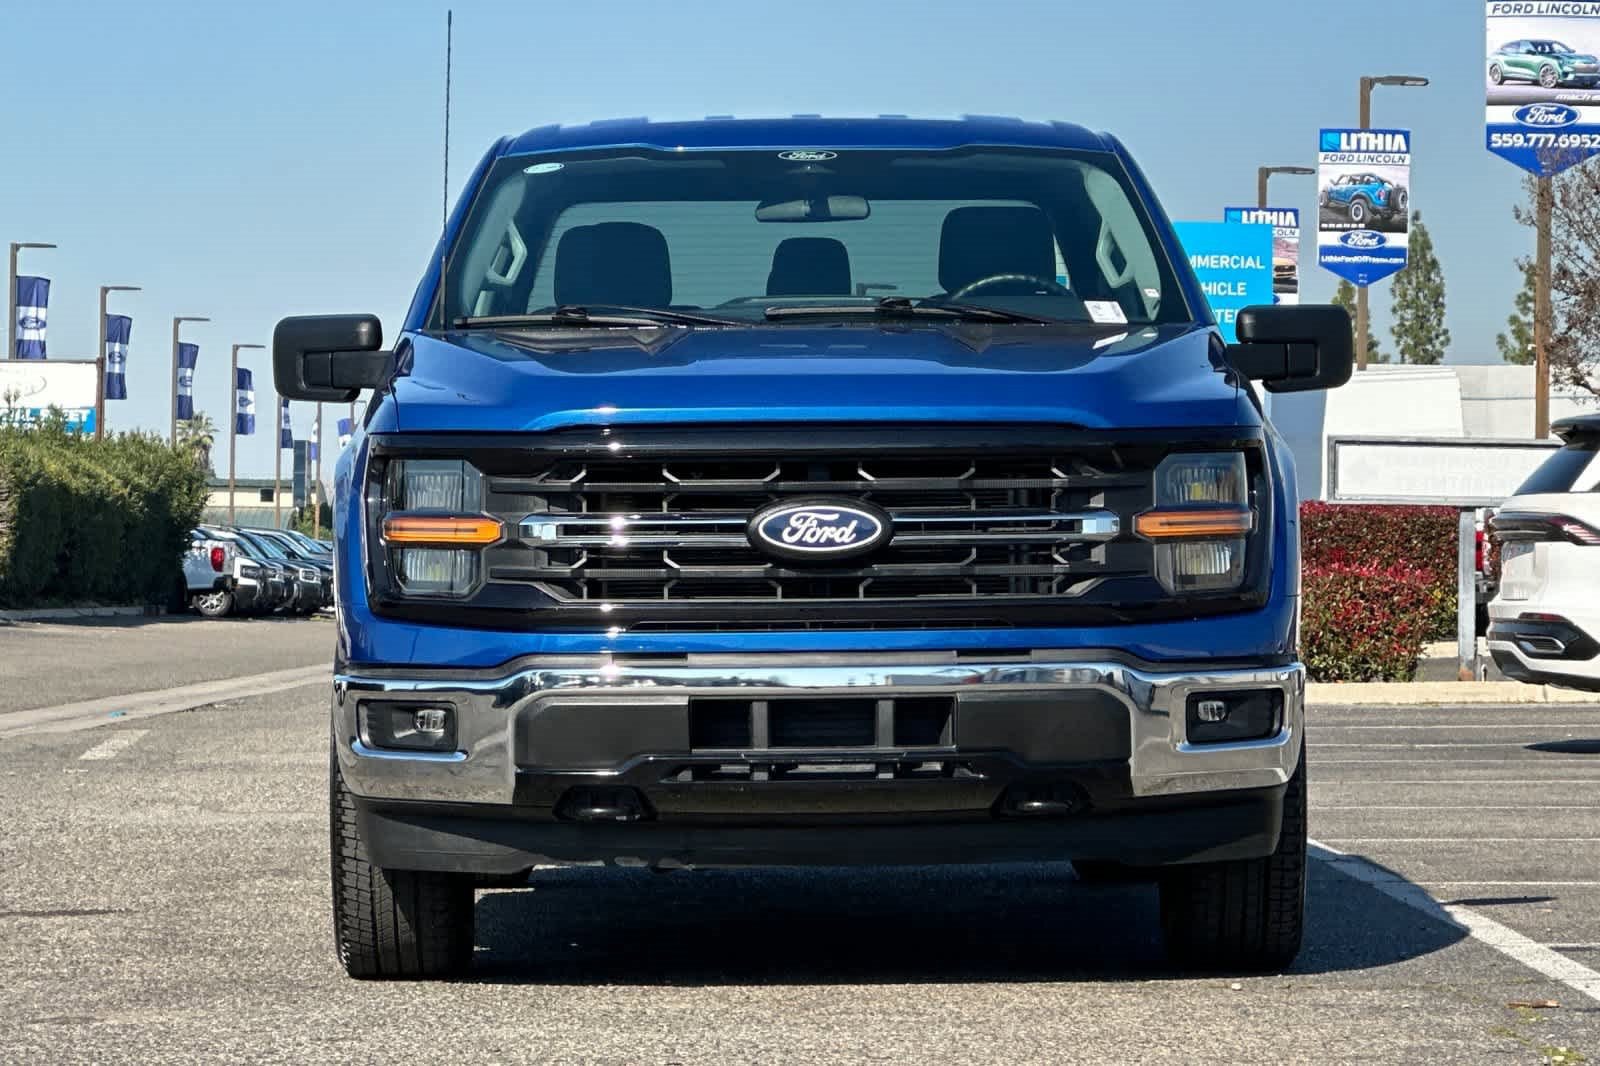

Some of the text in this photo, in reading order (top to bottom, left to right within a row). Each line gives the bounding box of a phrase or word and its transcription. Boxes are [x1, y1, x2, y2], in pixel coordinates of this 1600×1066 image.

[1492, 3, 1600, 15] FORD LINCOLN
[1526, 106, 1567, 124] Ford
[1341, 132, 1407, 152] LITHIA
[1491, 133, 1600, 148] 559.777.6952
[788, 151, 827, 161] Ford
[1323, 154, 1406, 164] FORD LINCOLN
[1241, 209, 1297, 226] LITHIA
[1347, 230, 1379, 246] Ford
[782, 512, 858, 543] Ford
